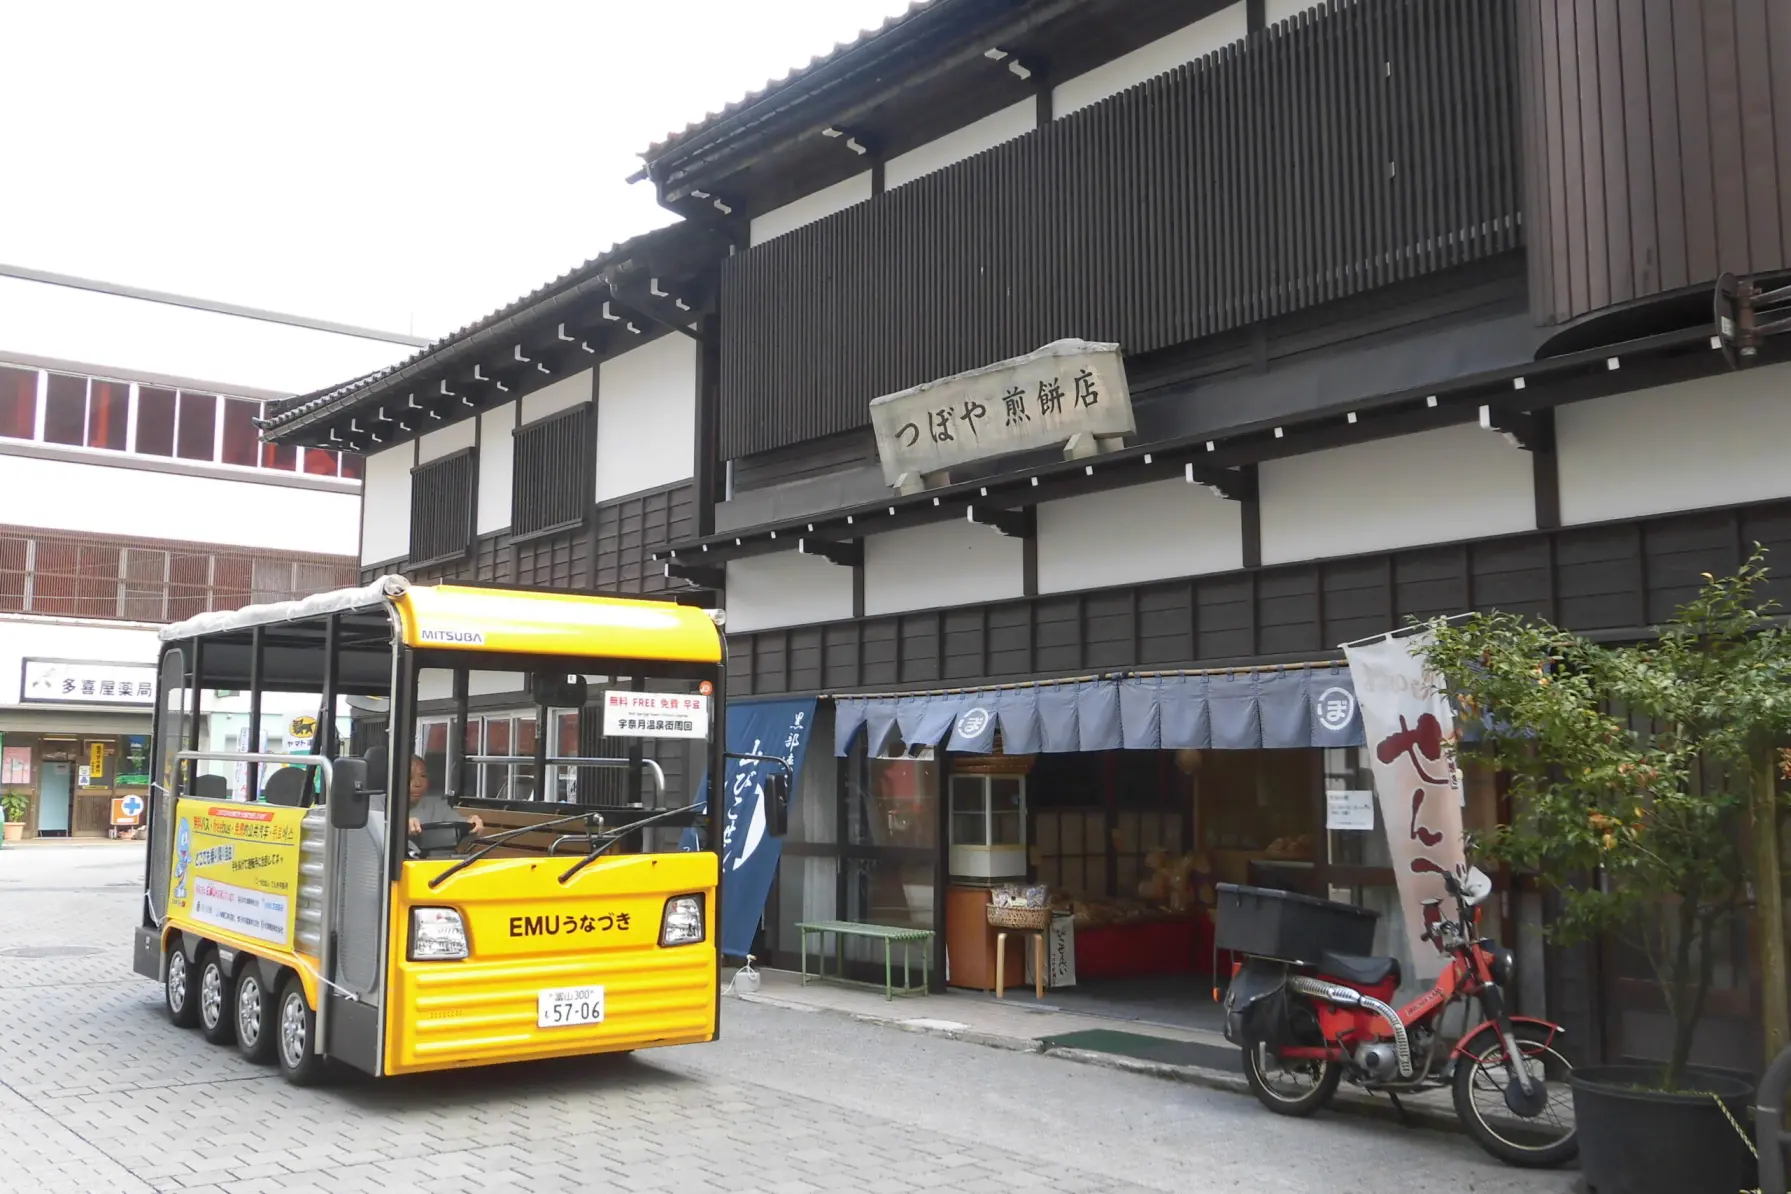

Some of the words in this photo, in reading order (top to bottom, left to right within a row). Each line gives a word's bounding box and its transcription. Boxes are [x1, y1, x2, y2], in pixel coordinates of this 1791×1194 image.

[895, 369, 1099, 447] つぼや煎餅店
[421, 630, 482, 643] MITSUBA
[62, 678, 152, 697] 多喜屋薬局
[609, 696, 628, 707] 無料
[632, 697, 656, 708] FREE
[684, 699, 701, 710] 무료
[618, 718, 693, 731] 宇奈月温泉街周回
[509, 912, 631, 937] EMUうなづき
[553, 1001, 600, 1022] 57-06
